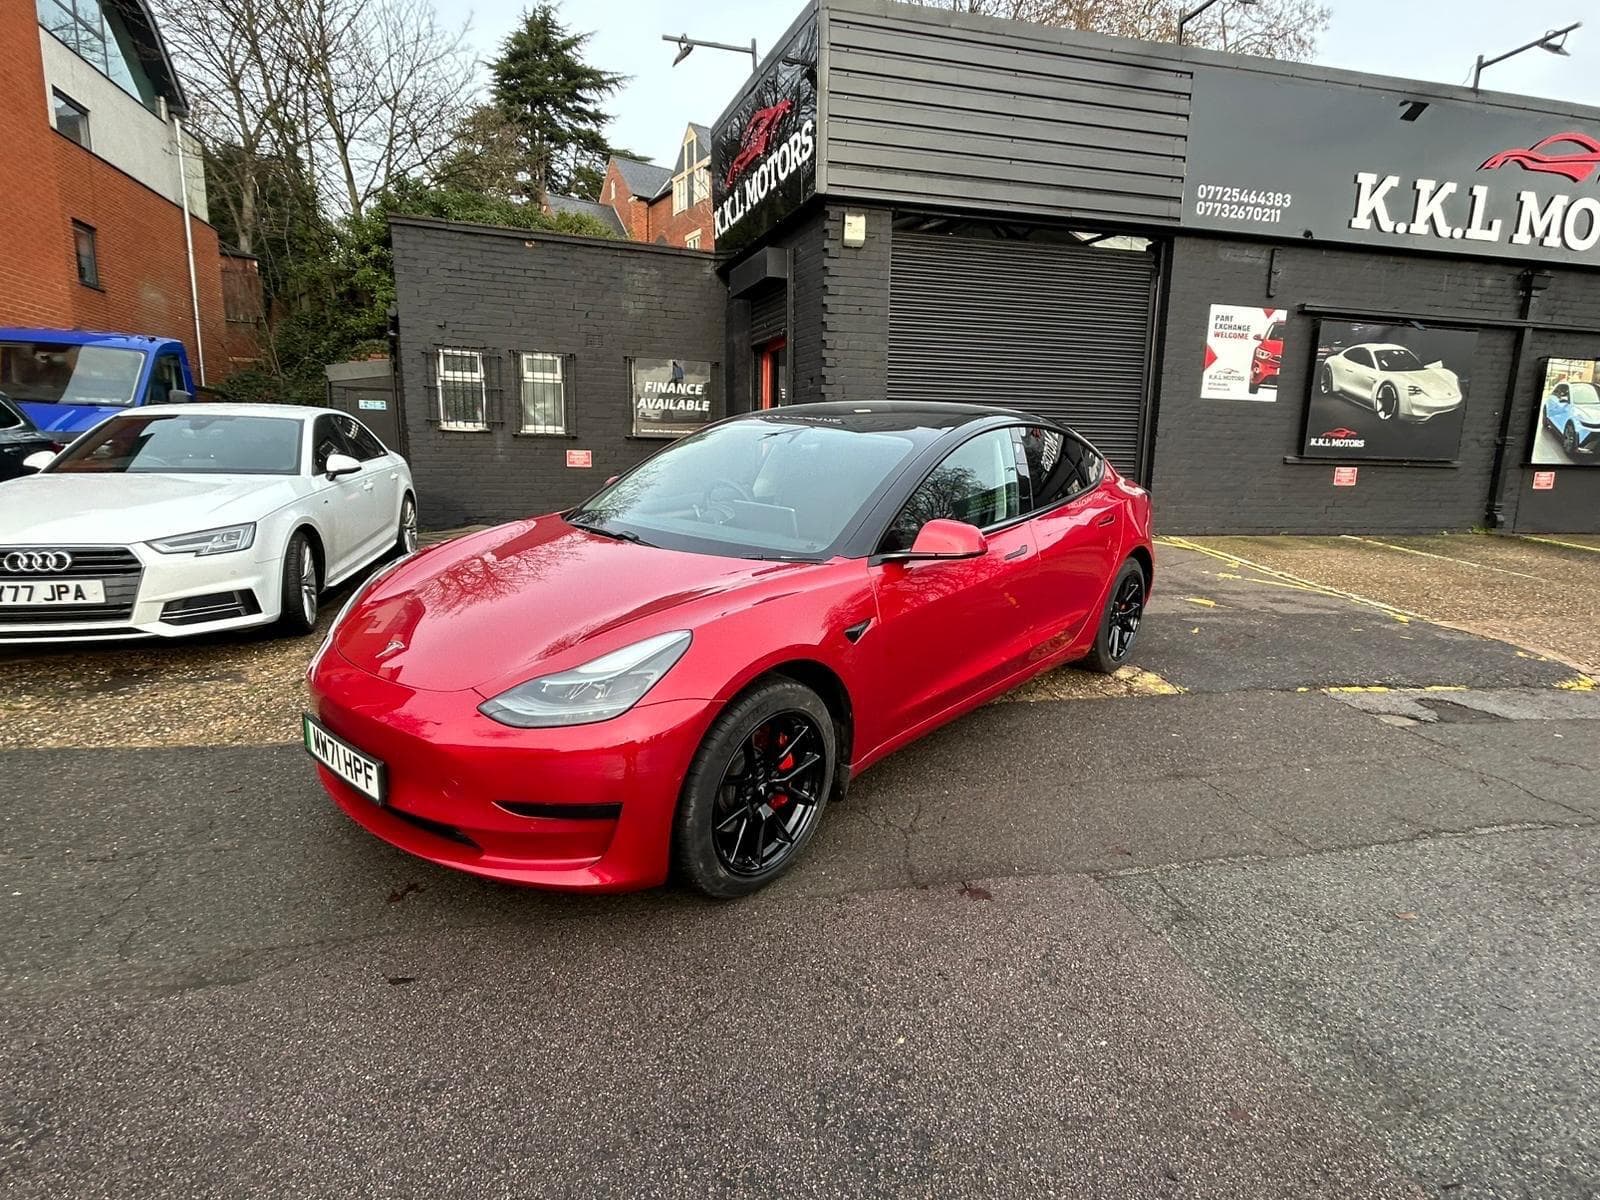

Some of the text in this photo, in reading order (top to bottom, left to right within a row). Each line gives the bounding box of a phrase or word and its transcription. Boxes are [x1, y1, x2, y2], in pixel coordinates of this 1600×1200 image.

[745, 119, 814, 212] MOTORS
[1197, 184, 1292, 208] 07725464383
[1196, 200, 1281, 223] 07732670211
[1351, 171, 1600, 252] K.K.L MO
[1215, 314, 1234, 322] PART
[1213, 331, 1249, 340] WELCOME
[1214, 323, 1251, 332] EXCHANGE
[644, 381, 704, 396] FINANCE
[637, 397, 711, 412] AVAILABLE
[1331, 438, 1365, 448] MOTORS
[43, 584, 87, 602] JPA
[343, 748, 374, 789] HPF
